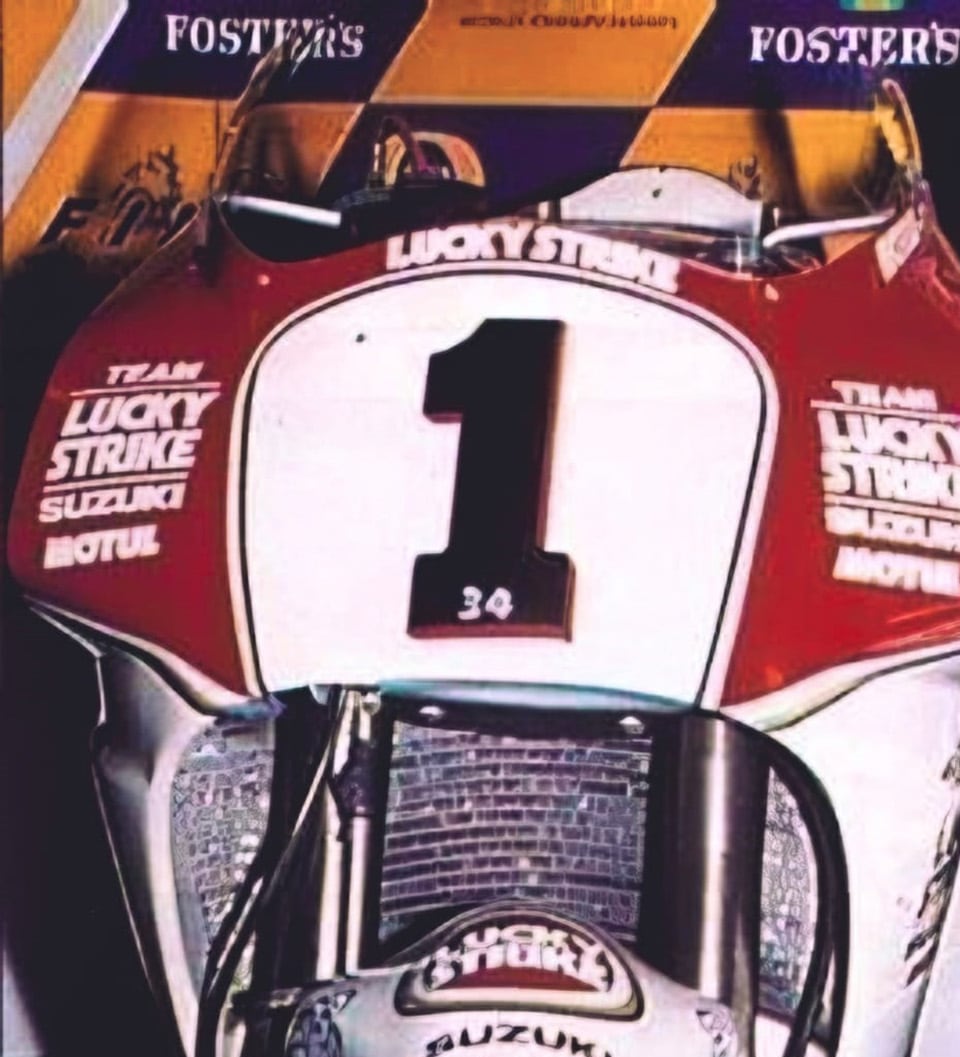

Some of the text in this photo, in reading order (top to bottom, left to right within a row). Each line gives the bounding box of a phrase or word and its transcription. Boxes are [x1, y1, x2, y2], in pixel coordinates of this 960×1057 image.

[750, 21, 960, 68] FOSTER'S
[107, 361, 204, 384] TEAM
[60, 391, 221, 437] LUCKY
[45, 428, 202, 481] STRIKE
[38, 482, 186, 522] SUZUKI
[407, 318, 576, 642] 1
[44, 524, 160, 569] MOTUL
